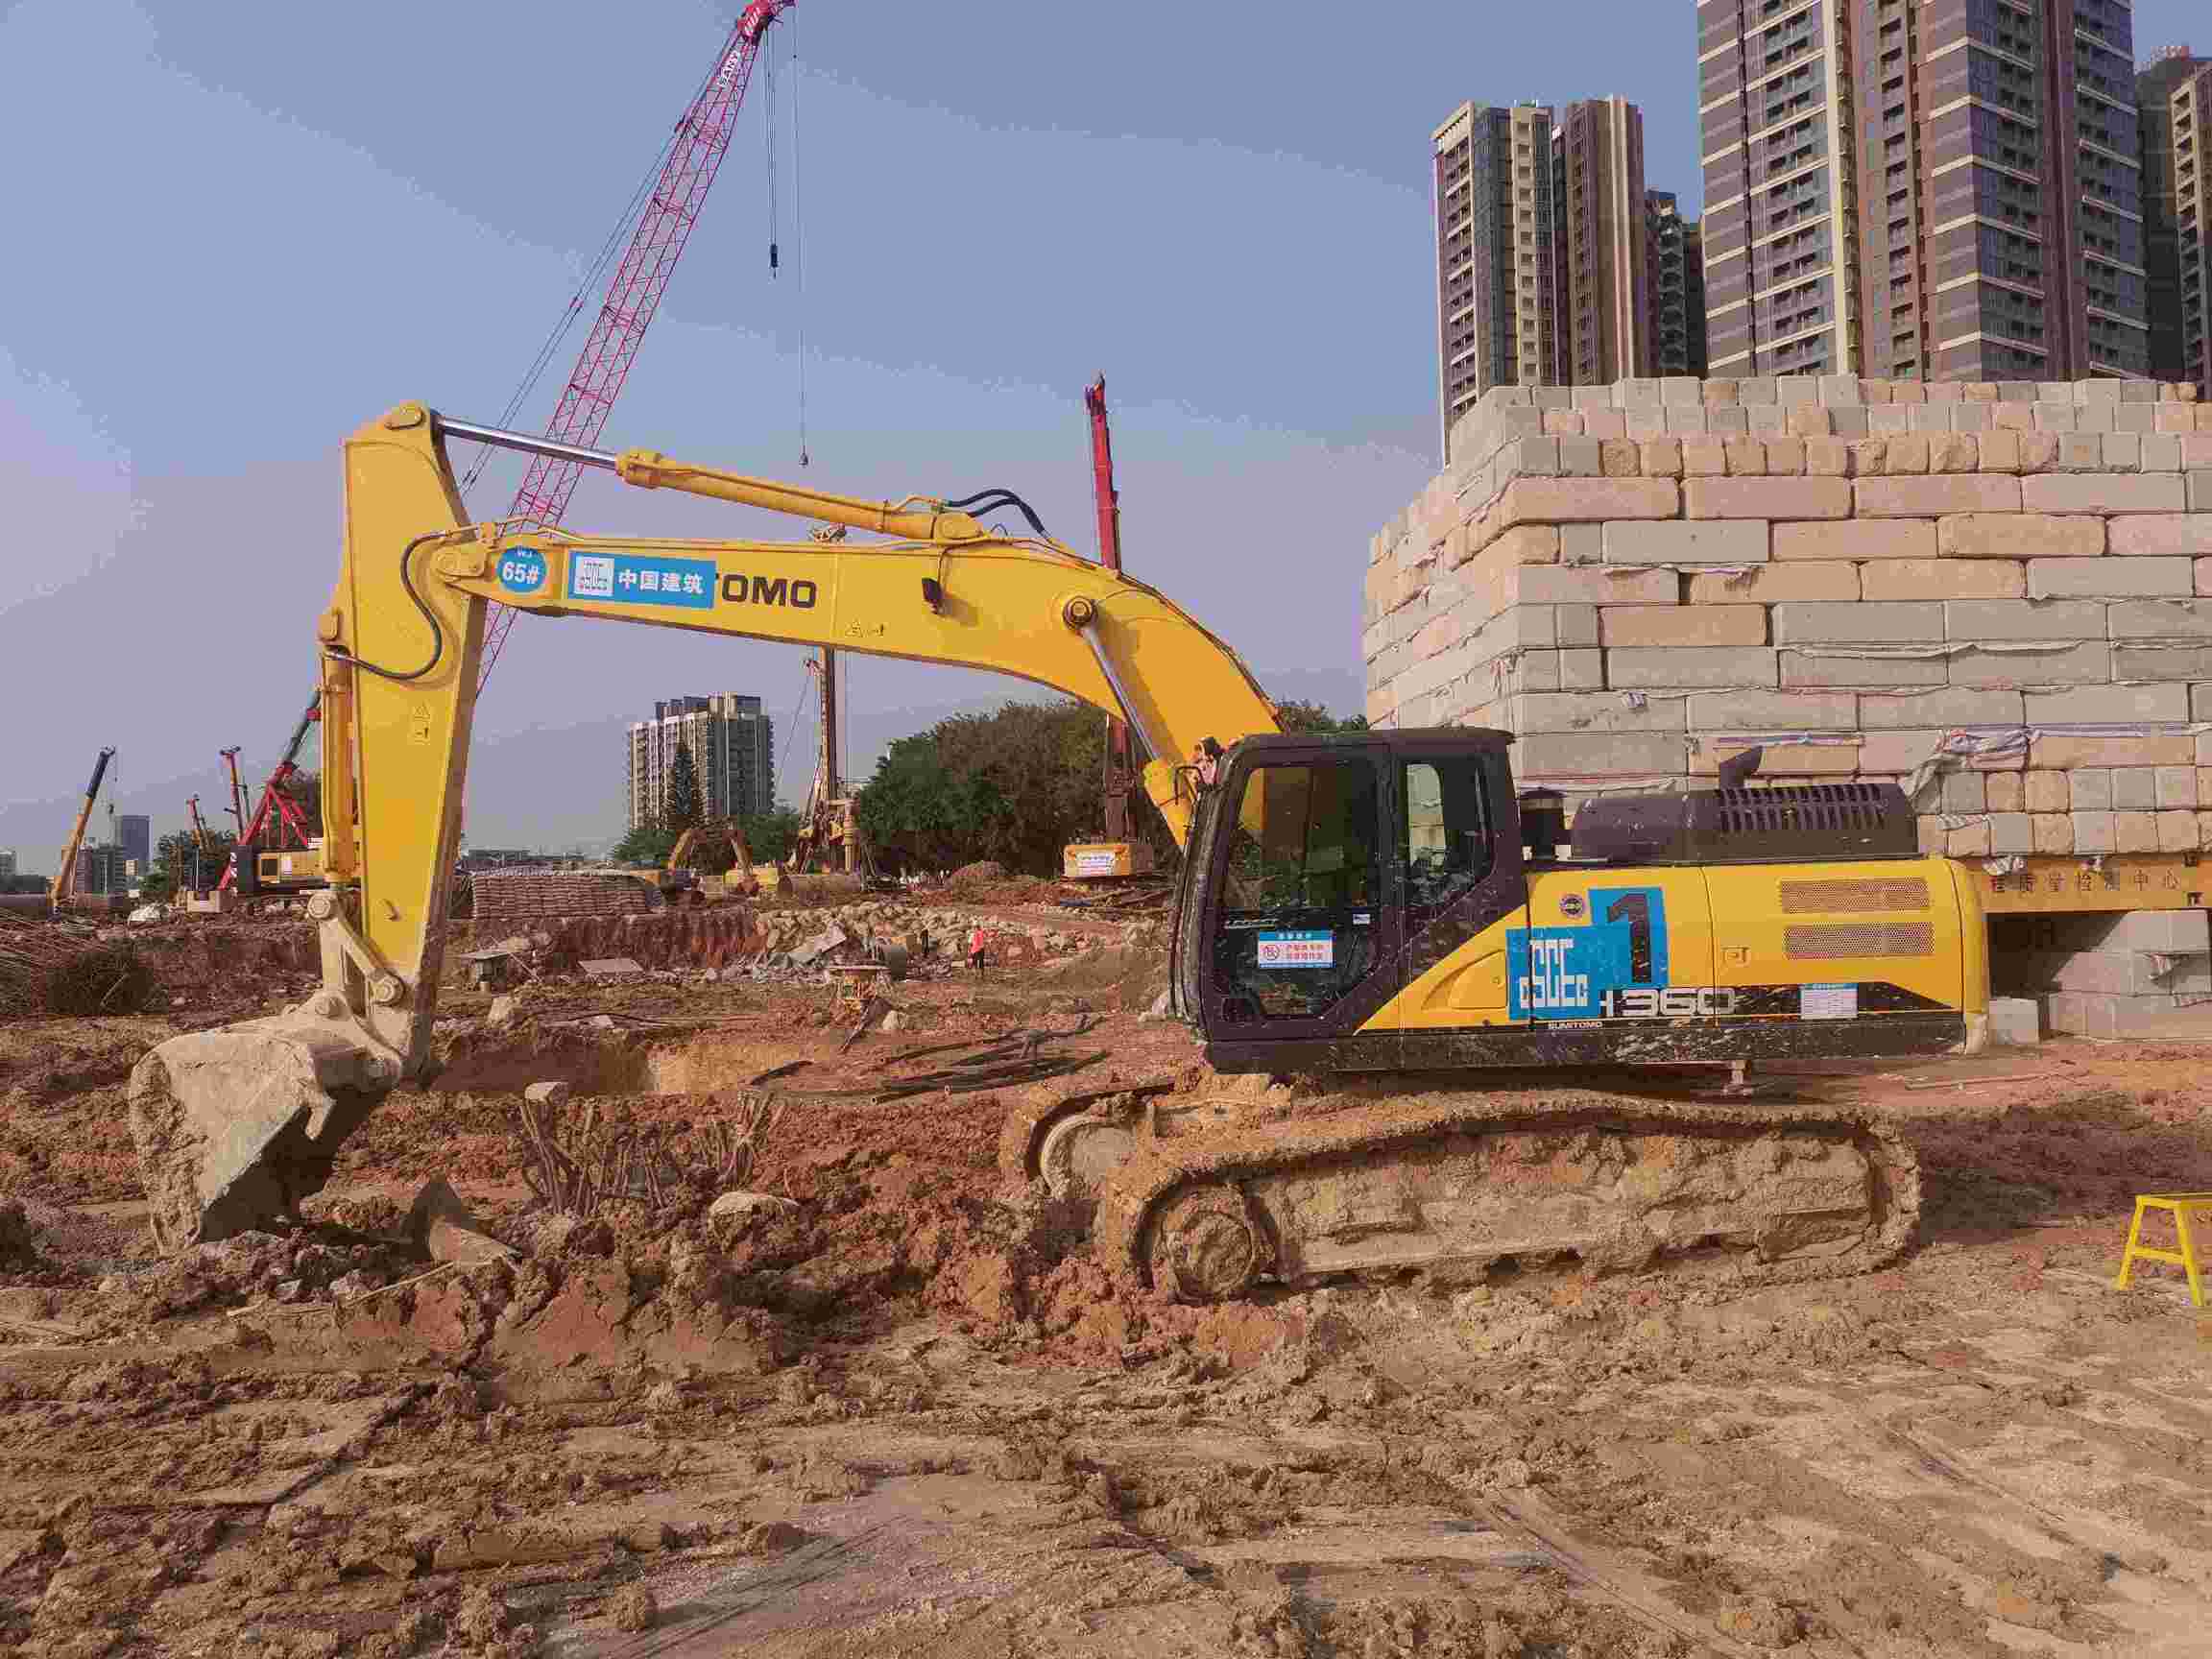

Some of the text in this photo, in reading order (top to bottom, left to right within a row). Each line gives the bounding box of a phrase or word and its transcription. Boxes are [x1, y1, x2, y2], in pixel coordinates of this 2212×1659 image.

[502, 561, 540, 585] 65#
[618, 569, 705, 594] 中国建筑
[715, 573, 817, 609] OMO
